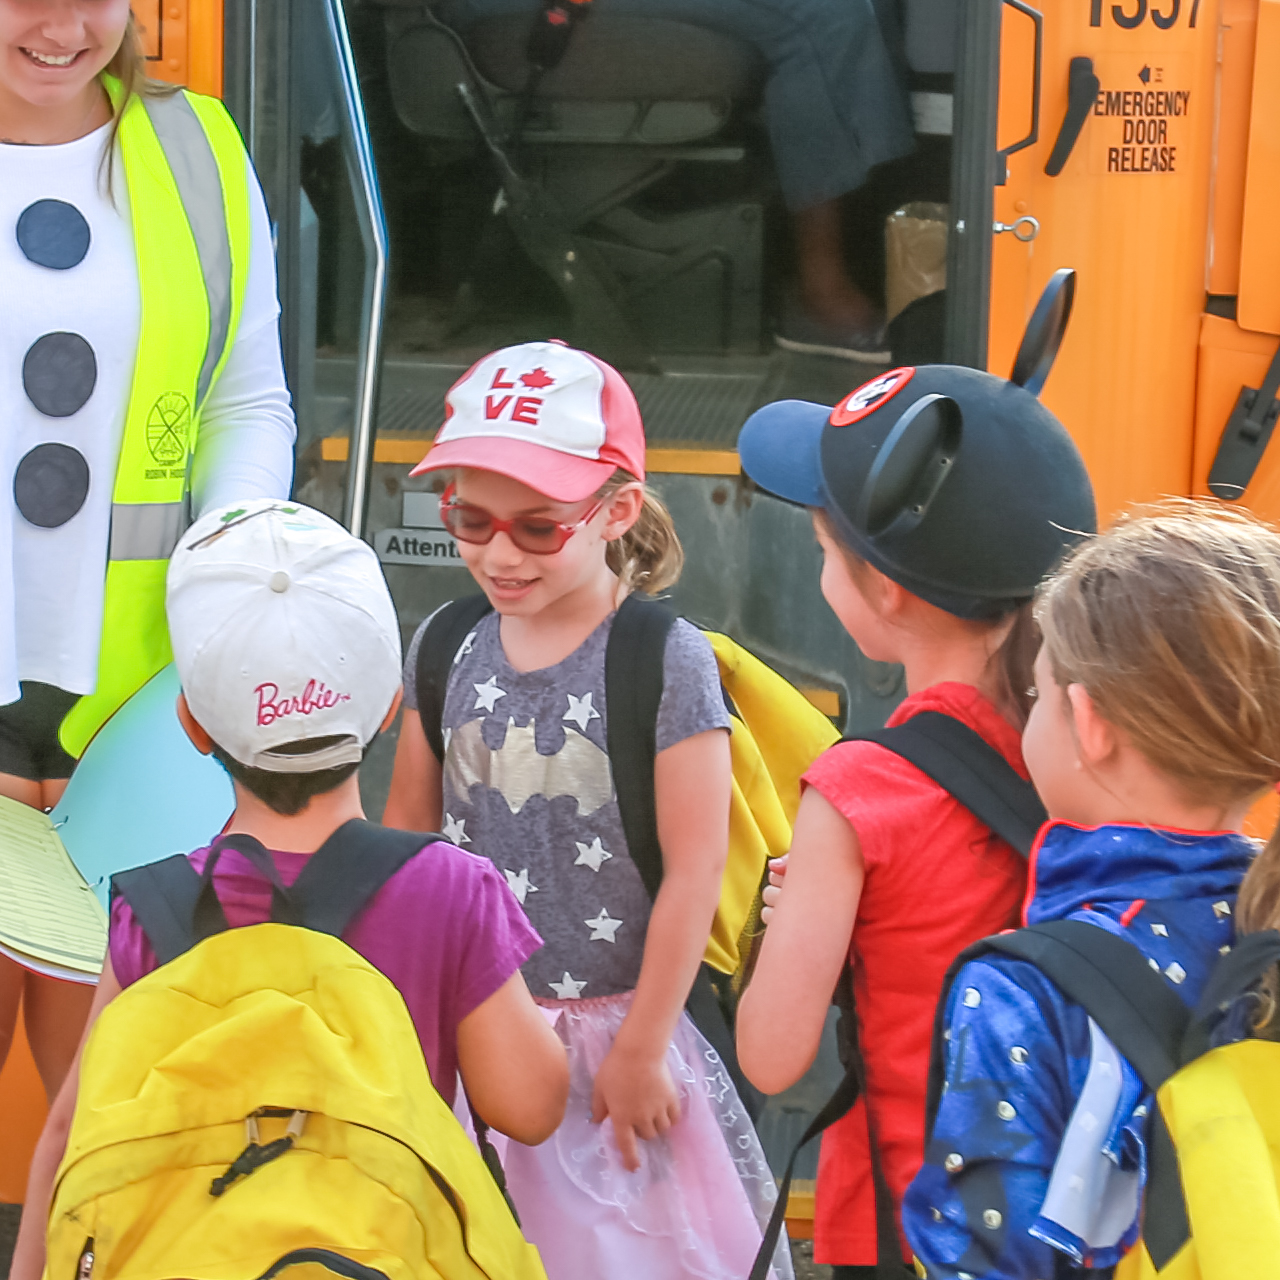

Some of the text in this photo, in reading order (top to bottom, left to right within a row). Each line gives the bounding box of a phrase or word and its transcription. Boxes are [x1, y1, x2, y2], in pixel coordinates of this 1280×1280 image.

[1094, 90, 1190, 116] EMERGENCY
[1123, 119, 1168, 145] DOOR
[1108, 147, 1176, 173] RELEASE
[254, 678, 339, 727] Barbie
